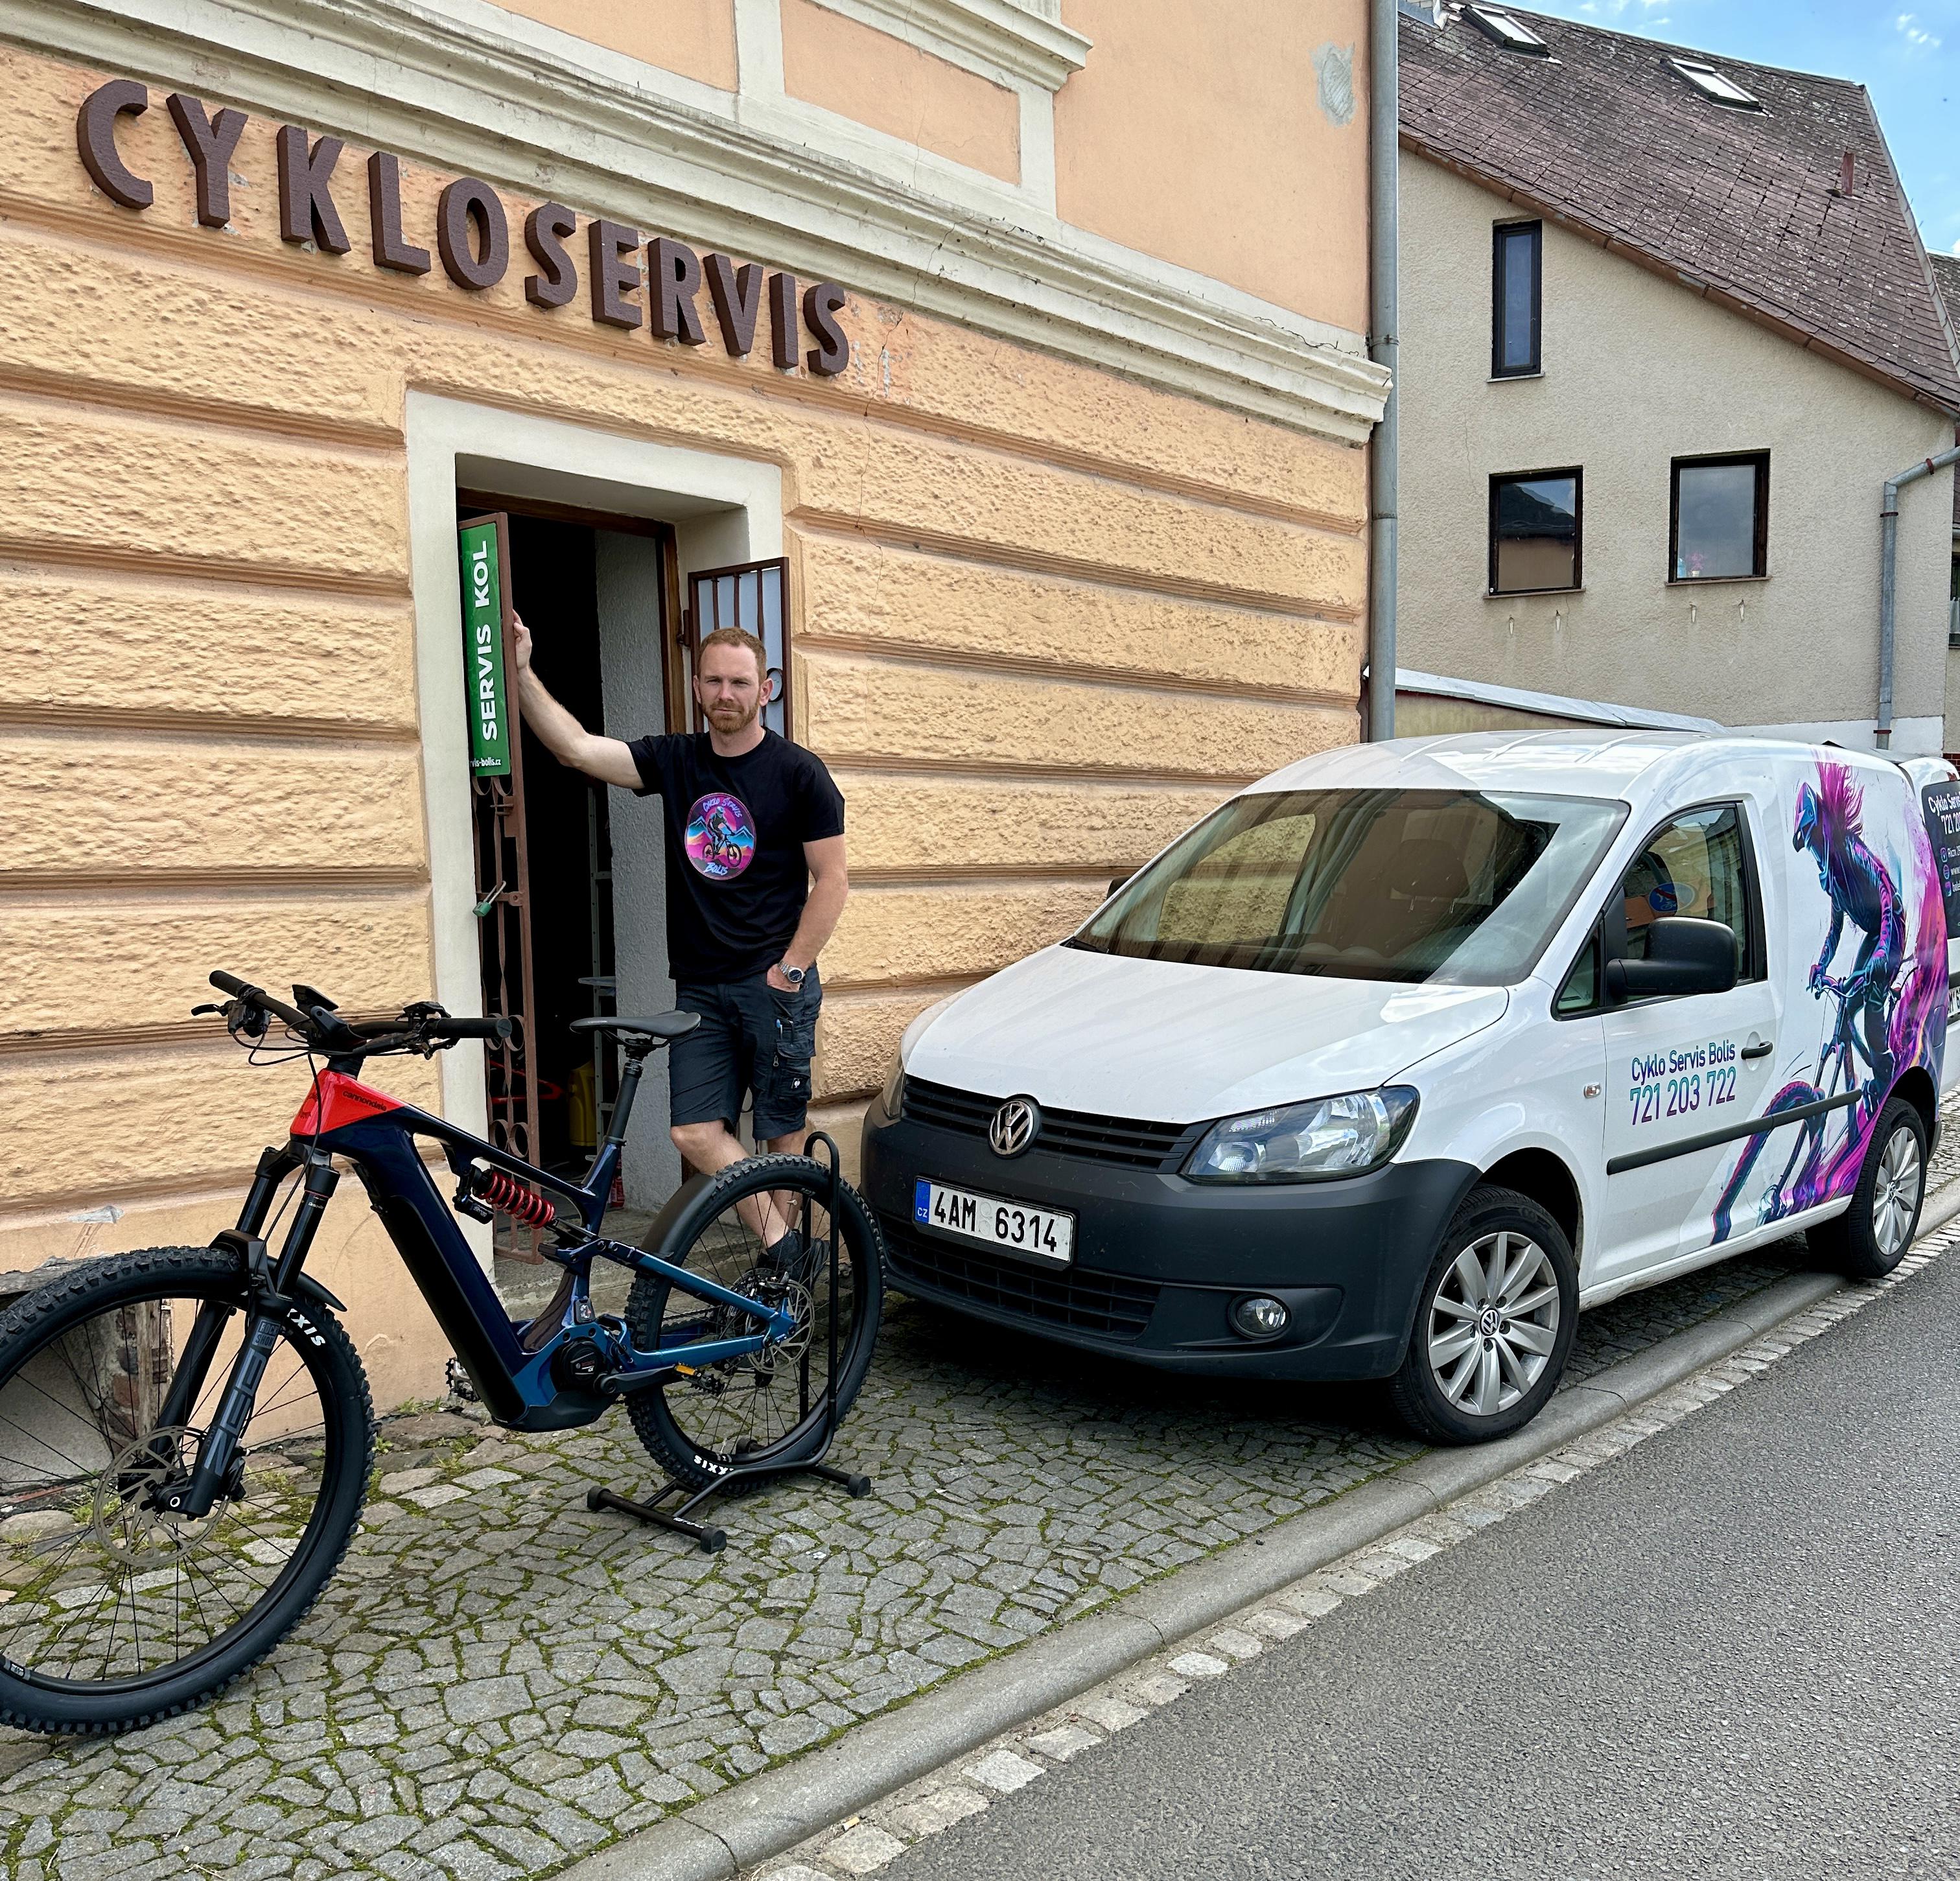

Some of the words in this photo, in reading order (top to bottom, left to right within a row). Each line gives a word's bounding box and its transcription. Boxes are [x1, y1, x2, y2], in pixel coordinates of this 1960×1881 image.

[76, 78, 851, 377] CYKLOSERVIS
[472, 540, 489, 608] KOL
[477, 622, 497, 741] SERVIS
[1631, 1053, 1666, 1085] Cyklo
[1669, 1045, 1705, 1073] Servis
[1709, 1039, 1735, 1065] Bolis
[342, 1090, 387, 1112] cannondale
[1629, 1082, 1661, 1125] 721
[1666, 1074, 1700, 1117] 203
[1707, 1066, 1736, 1106] 722
[917, 1206, 928, 1218] CZ
[934, 1191, 977, 1232] 4AM
[995, 1206, 1057, 1252] 6314
[694, 1455, 734, 1475] XXIS
